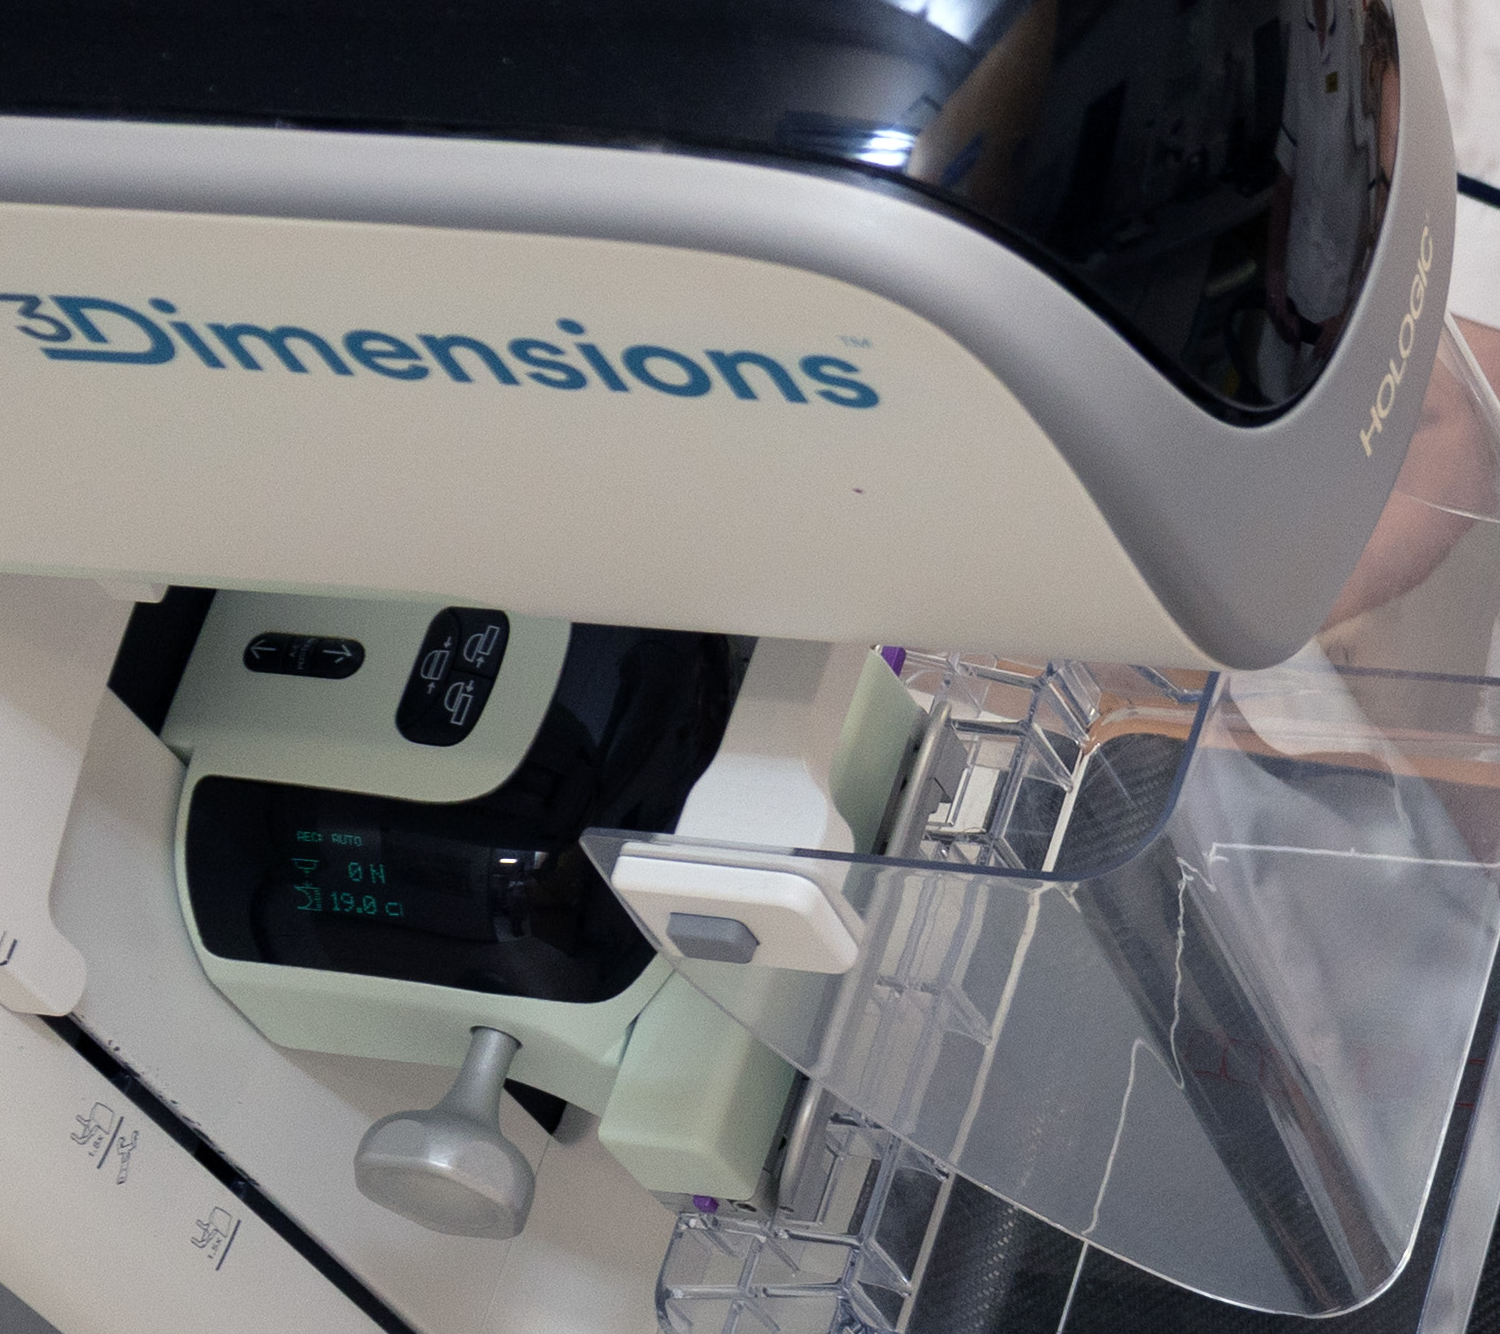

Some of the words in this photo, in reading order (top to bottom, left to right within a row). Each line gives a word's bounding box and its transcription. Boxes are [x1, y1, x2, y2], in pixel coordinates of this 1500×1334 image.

[1358, 225, 1434, 458] HOLOGIC
[331, 833, 363, 847] AUTO
[348, 861, 363, 882] 0
[331, 891, 377, 915] 19.0
